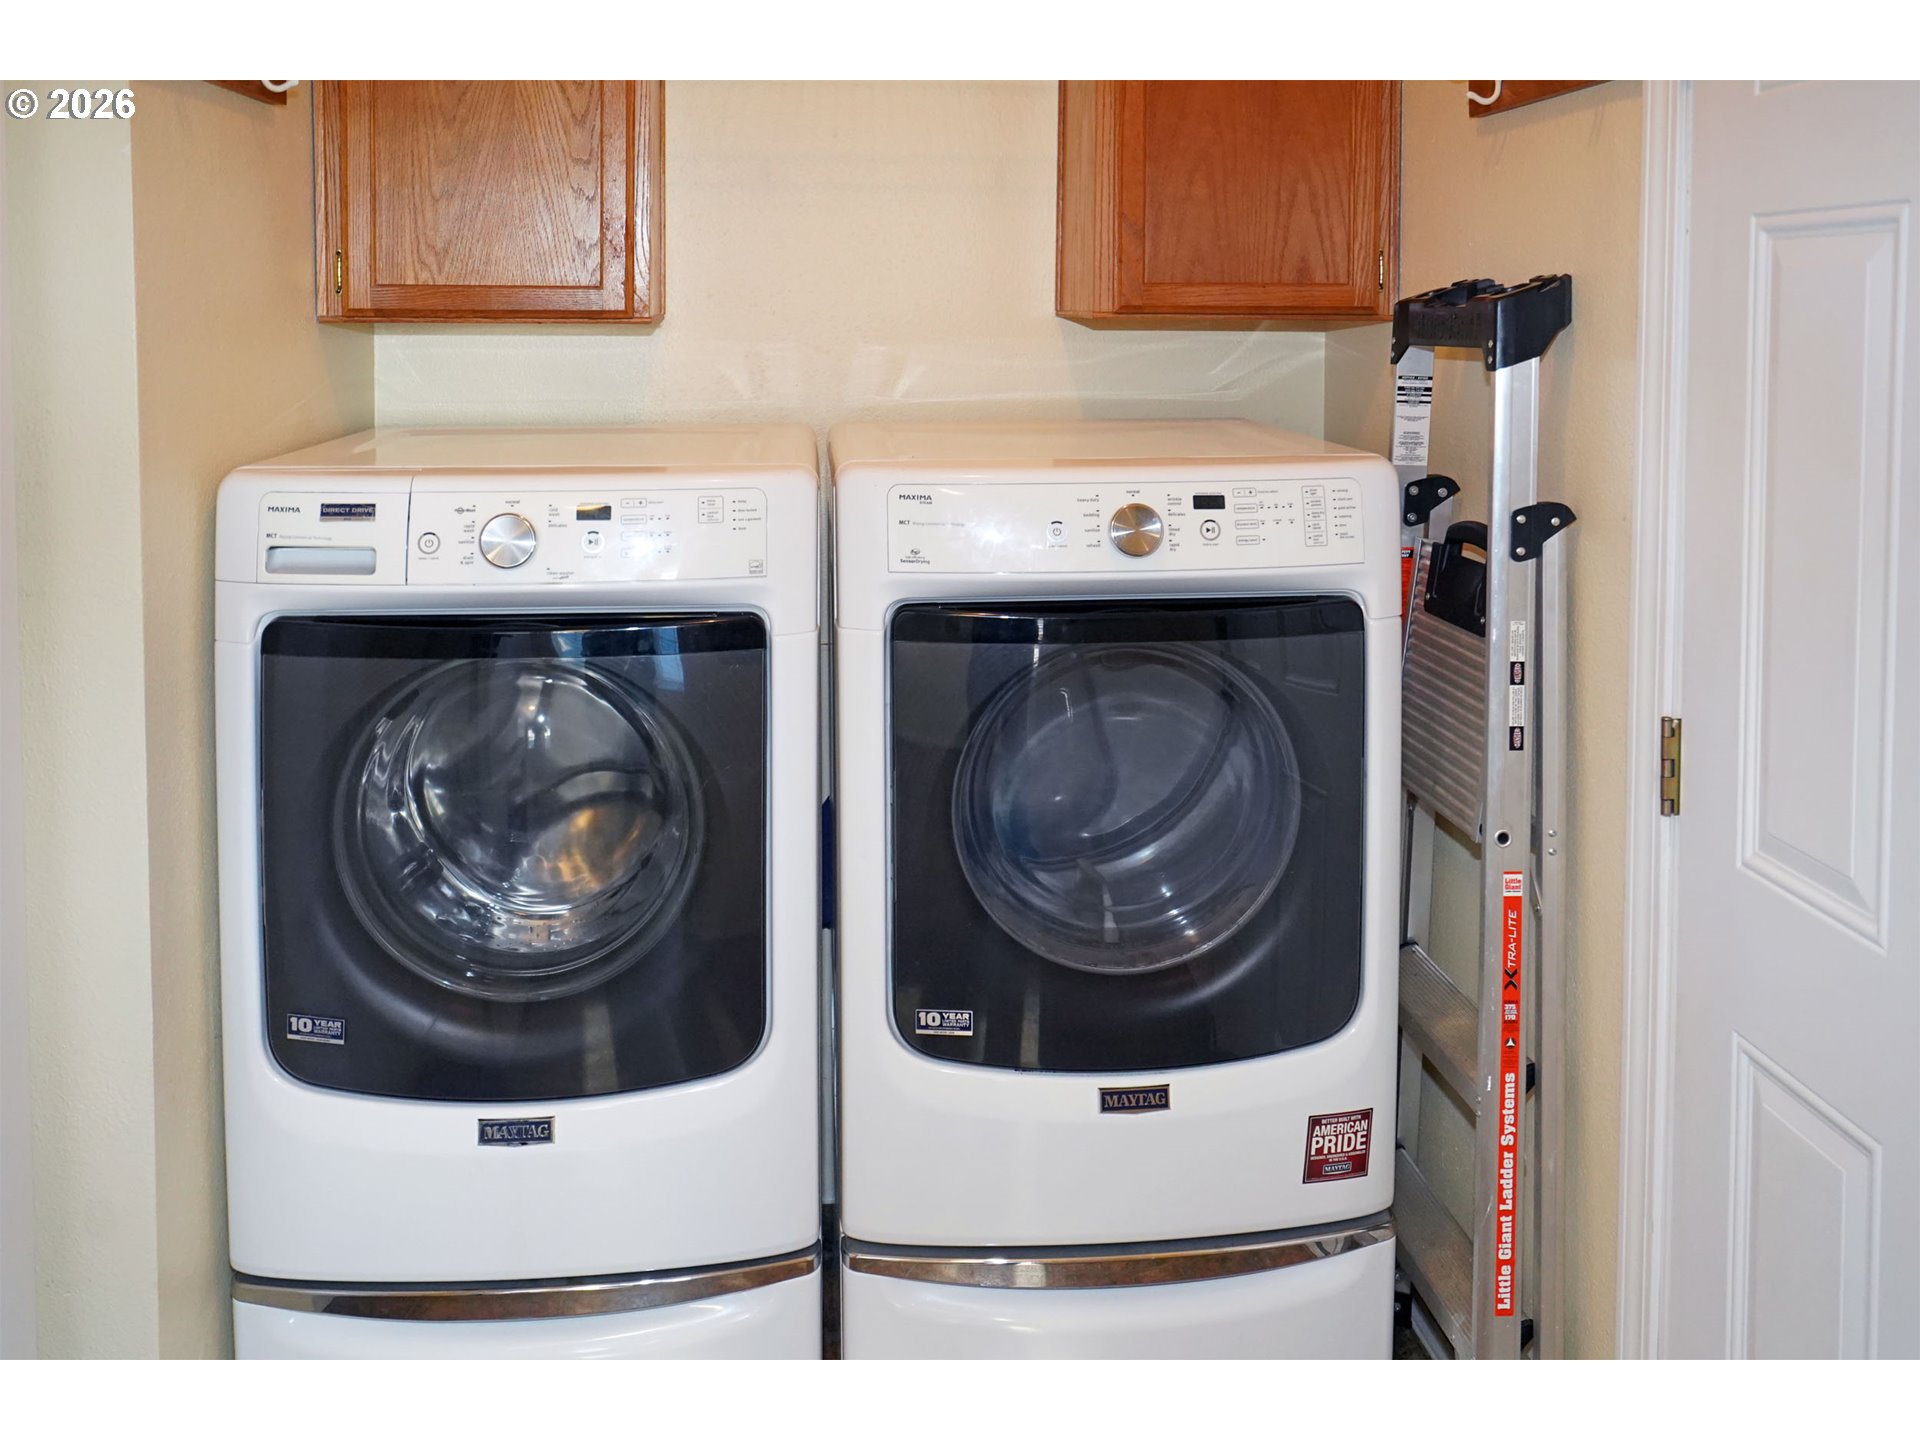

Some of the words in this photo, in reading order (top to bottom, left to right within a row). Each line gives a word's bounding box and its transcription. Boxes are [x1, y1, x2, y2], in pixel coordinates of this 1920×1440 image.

[290, 1016, 313, 1033] 10
[313, 1019, 342, 1028] YEAR
[918, 1011, 941, 1027] 10
[942, 1012, 970, 1020] YEAR
[1104, 1092, 1166, 1108] MAYTAG
[1500, 1072, 1516, 1147] Systems
[484, 1124, 550, 1140] MAYTAG
[1313, 1119, 1368, 1137] AMERICAN
[1310, 1131, 1367, 1155] PRIDE
[1324, 1164, 1350, 1172] MAYTAG
[1499, 1151, 1514, 1211] Ladder
[1498, 1215, 1513, 1260] Giant
[1497, 1264, 1512, 1310] Little
